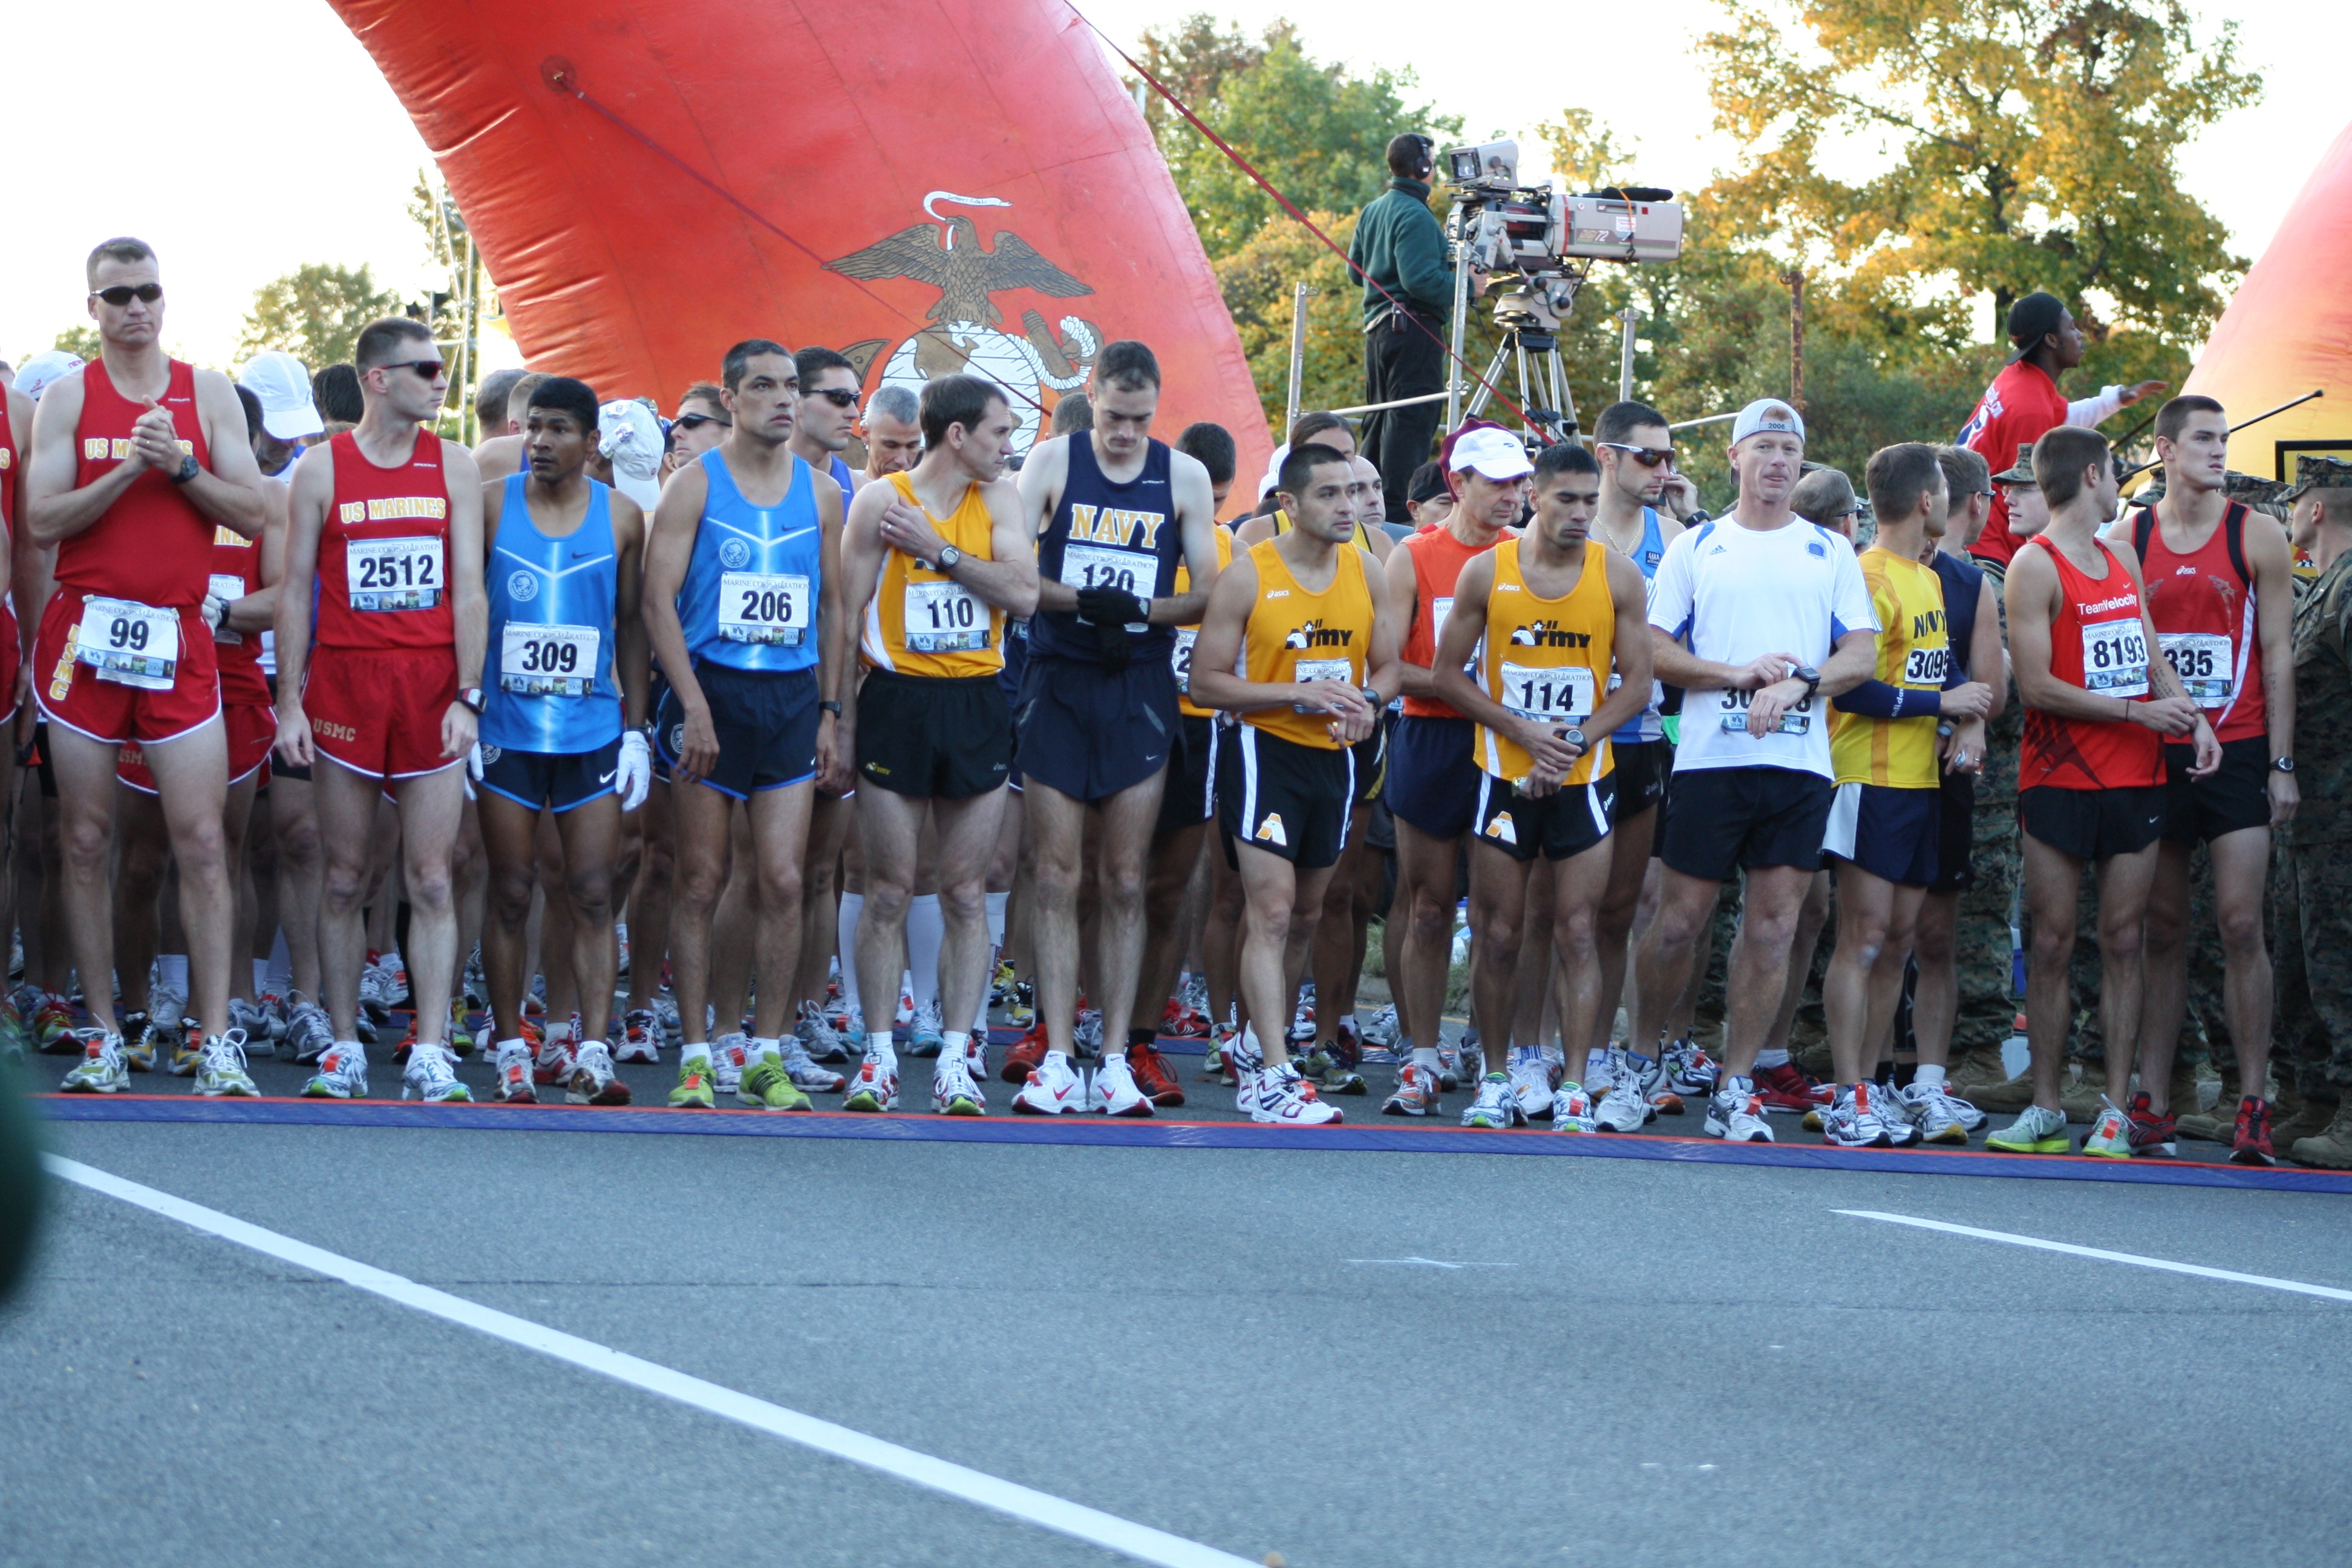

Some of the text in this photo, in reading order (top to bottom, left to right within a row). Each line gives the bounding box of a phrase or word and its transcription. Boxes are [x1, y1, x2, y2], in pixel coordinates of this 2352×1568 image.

[1595, 230, 1609, 241] 72
[84, 437, 109, 460] US
[339, 496, 446, 524] US MARINES
[1068, 503, 1165, 549] NAVY
[359, 554, 434, 588] 2512
[724, 578, 752, 587] MARINE
[87, 604, 174, 622] MARINE CORPS MARATHO
[740, 590, 792, 622] 206
[927, 598, 974, 629] 110
[109, 618, 149, 651] 99
[505, 629, 533, 638] MARINE
[50, 623, 81, 701] USMC
[522, 640, 578, 673] 309
[2093, 635, 2146, 668] 8193
[1502, 668, 1593, 681] MARINE CORPS MARATHON
[1521, 680, 1575, 711] 114
[313, 717, 356, 742] USMC
